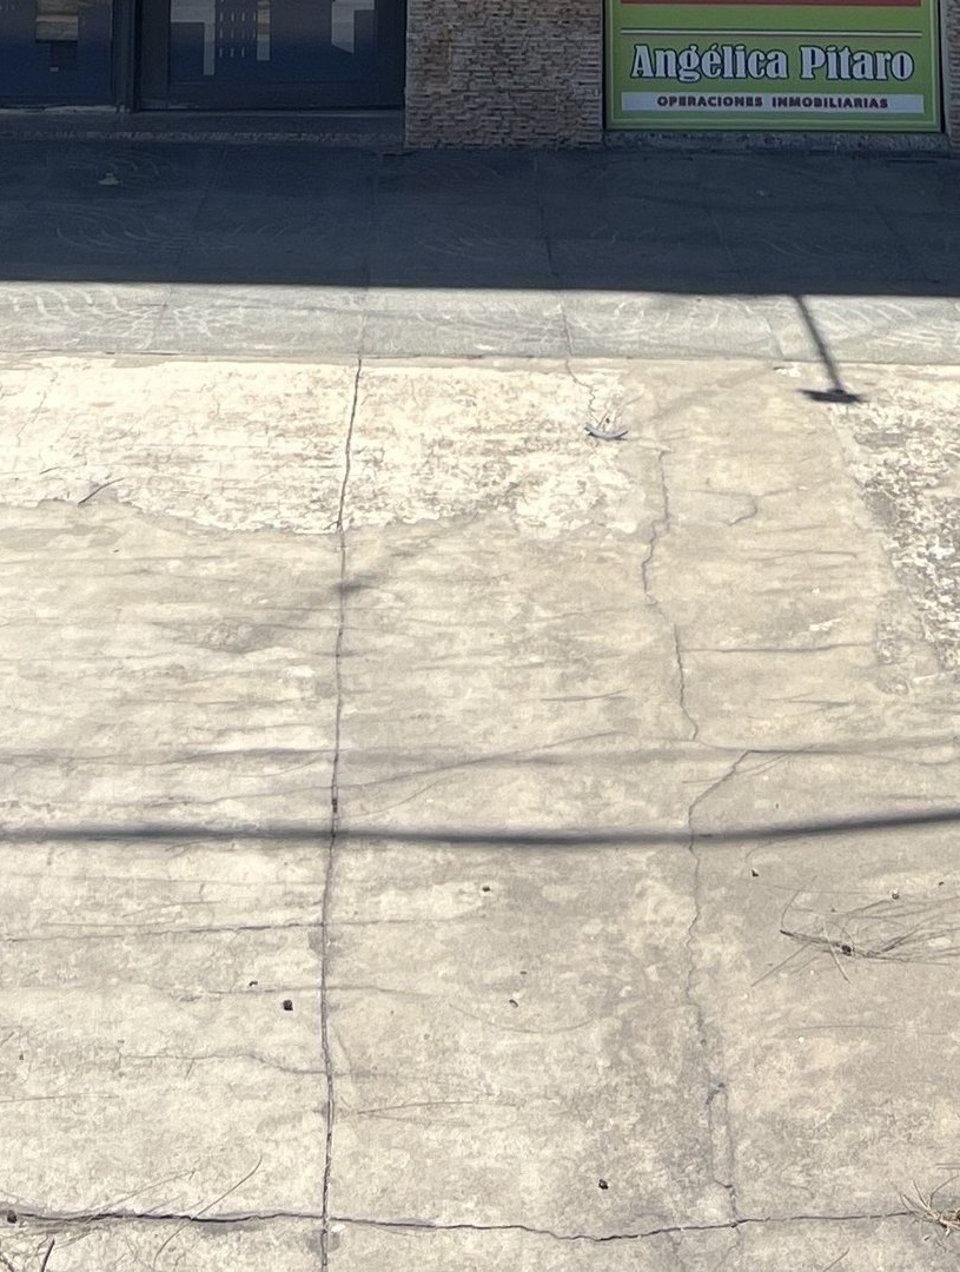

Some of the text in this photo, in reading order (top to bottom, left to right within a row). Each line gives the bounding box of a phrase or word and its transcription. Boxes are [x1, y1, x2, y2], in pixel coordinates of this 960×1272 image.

[630, 43, 914, 83] Angélica Pitaro
[656, 95, 889, 109] OPERACIONES INMOBILIARIAS
